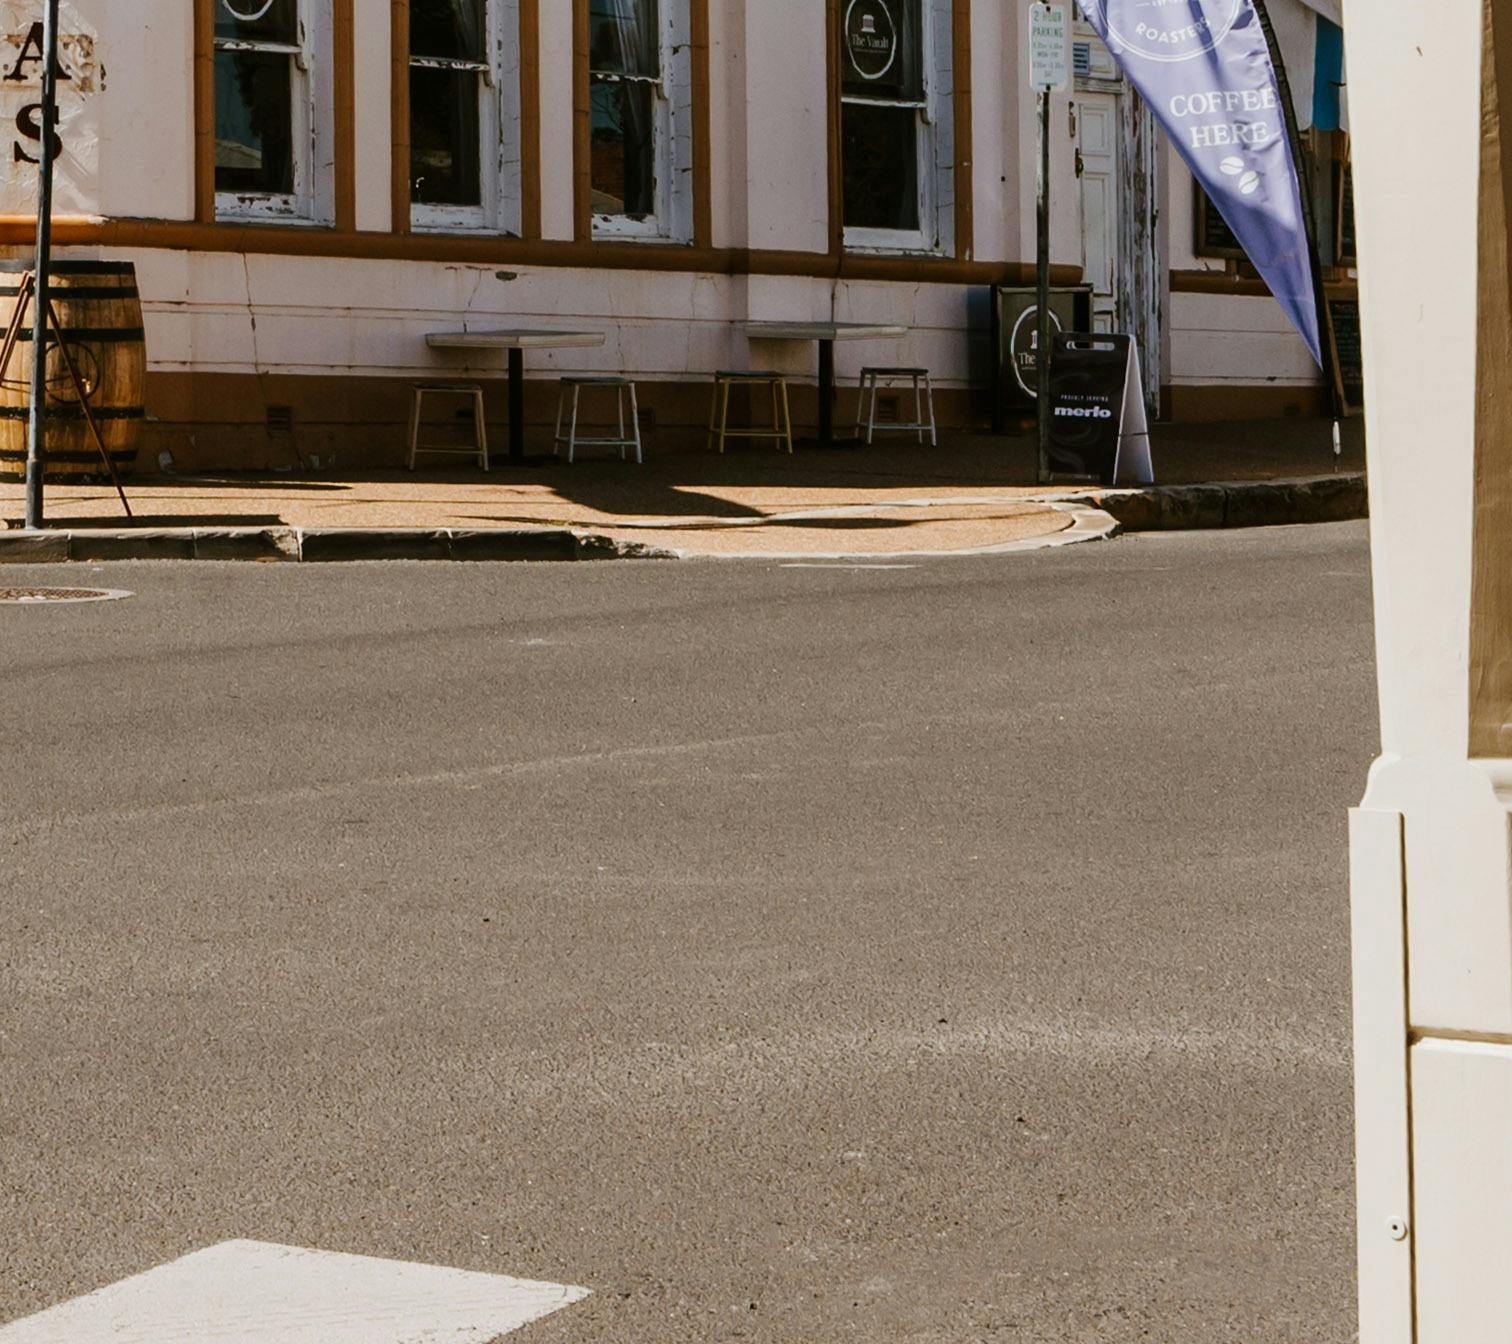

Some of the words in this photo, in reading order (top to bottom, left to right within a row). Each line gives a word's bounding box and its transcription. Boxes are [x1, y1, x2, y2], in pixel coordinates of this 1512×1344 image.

[1135, 16, 1211, 44] ROASTERS
[1169, 87, 1277, 117] COFFEE
[1190, 121, 1271, 149] HERE
[1018, 352, 1036, 365] The
[1054, 405, 1112, 418] merlo
